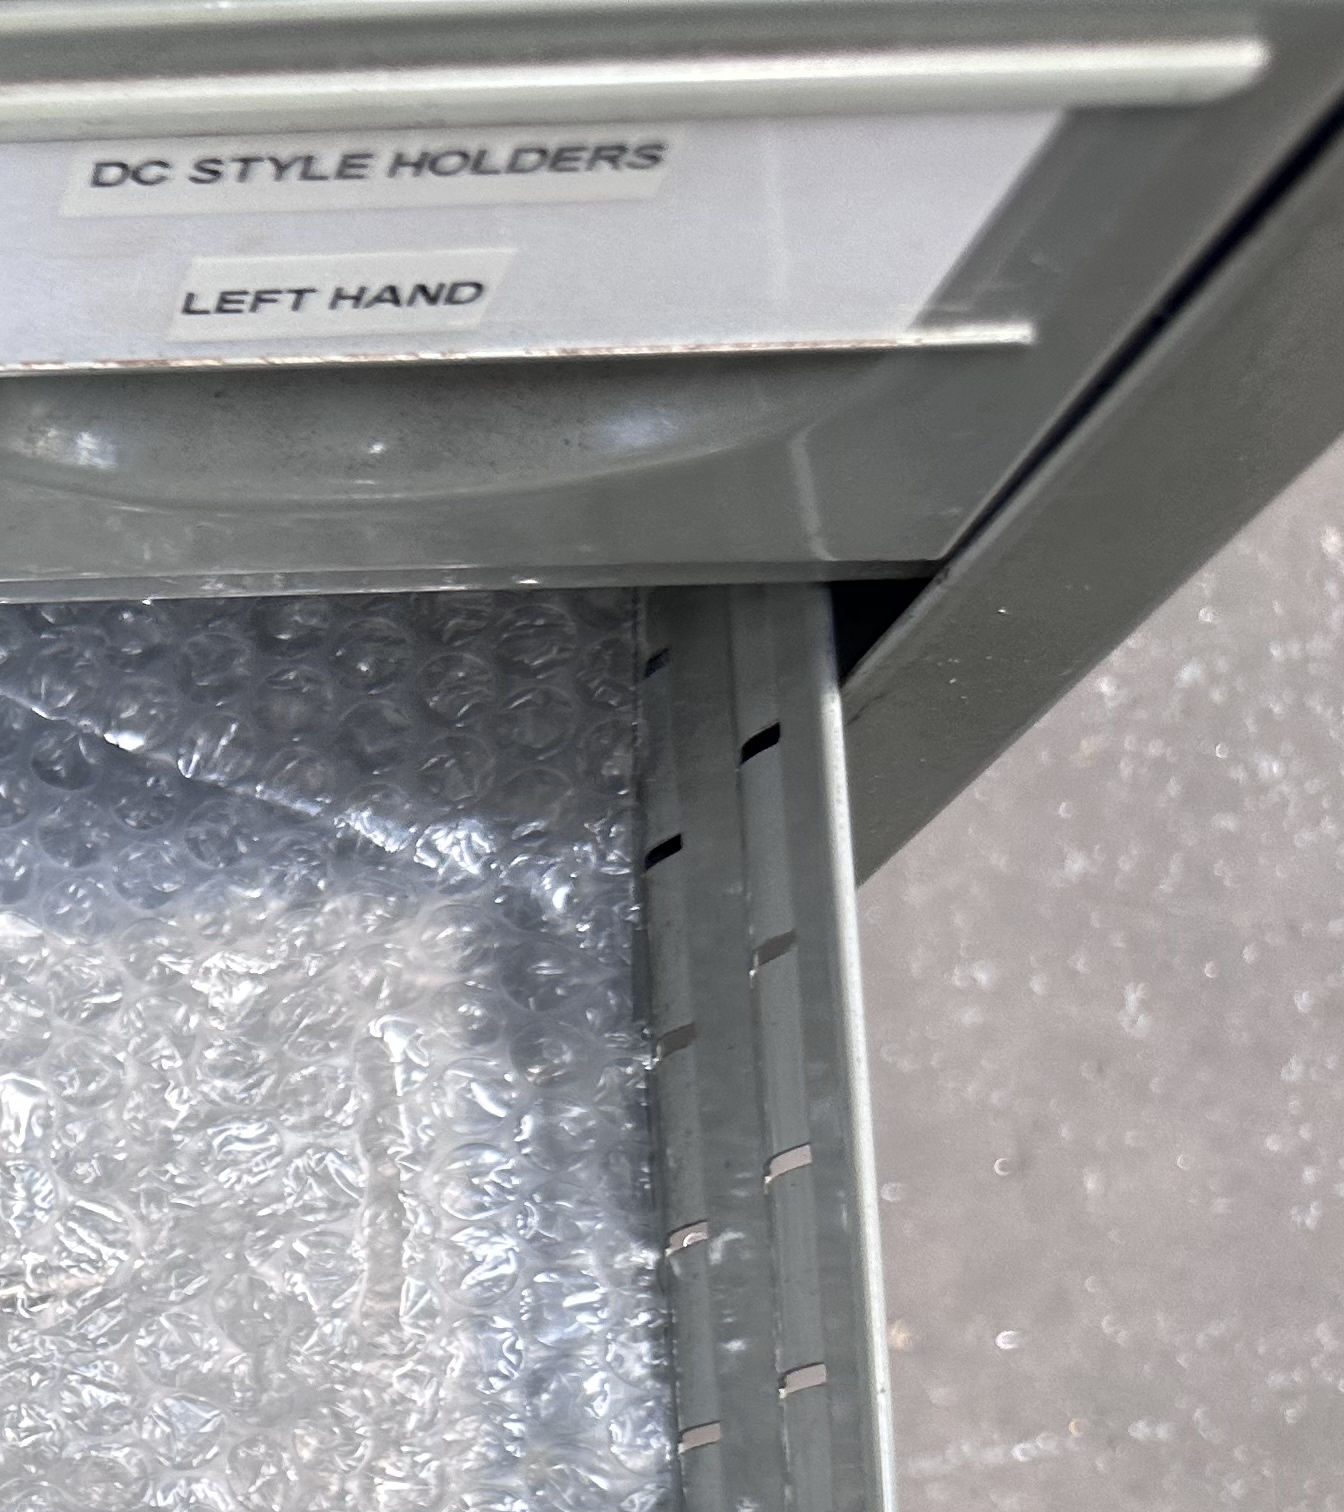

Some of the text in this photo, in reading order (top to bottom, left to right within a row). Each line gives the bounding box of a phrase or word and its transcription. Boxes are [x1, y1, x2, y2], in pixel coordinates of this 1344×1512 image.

[89, 142, 669, 189] DC STYLE HOLDERS
[179, 279, 485, 316] LEFT HAND
